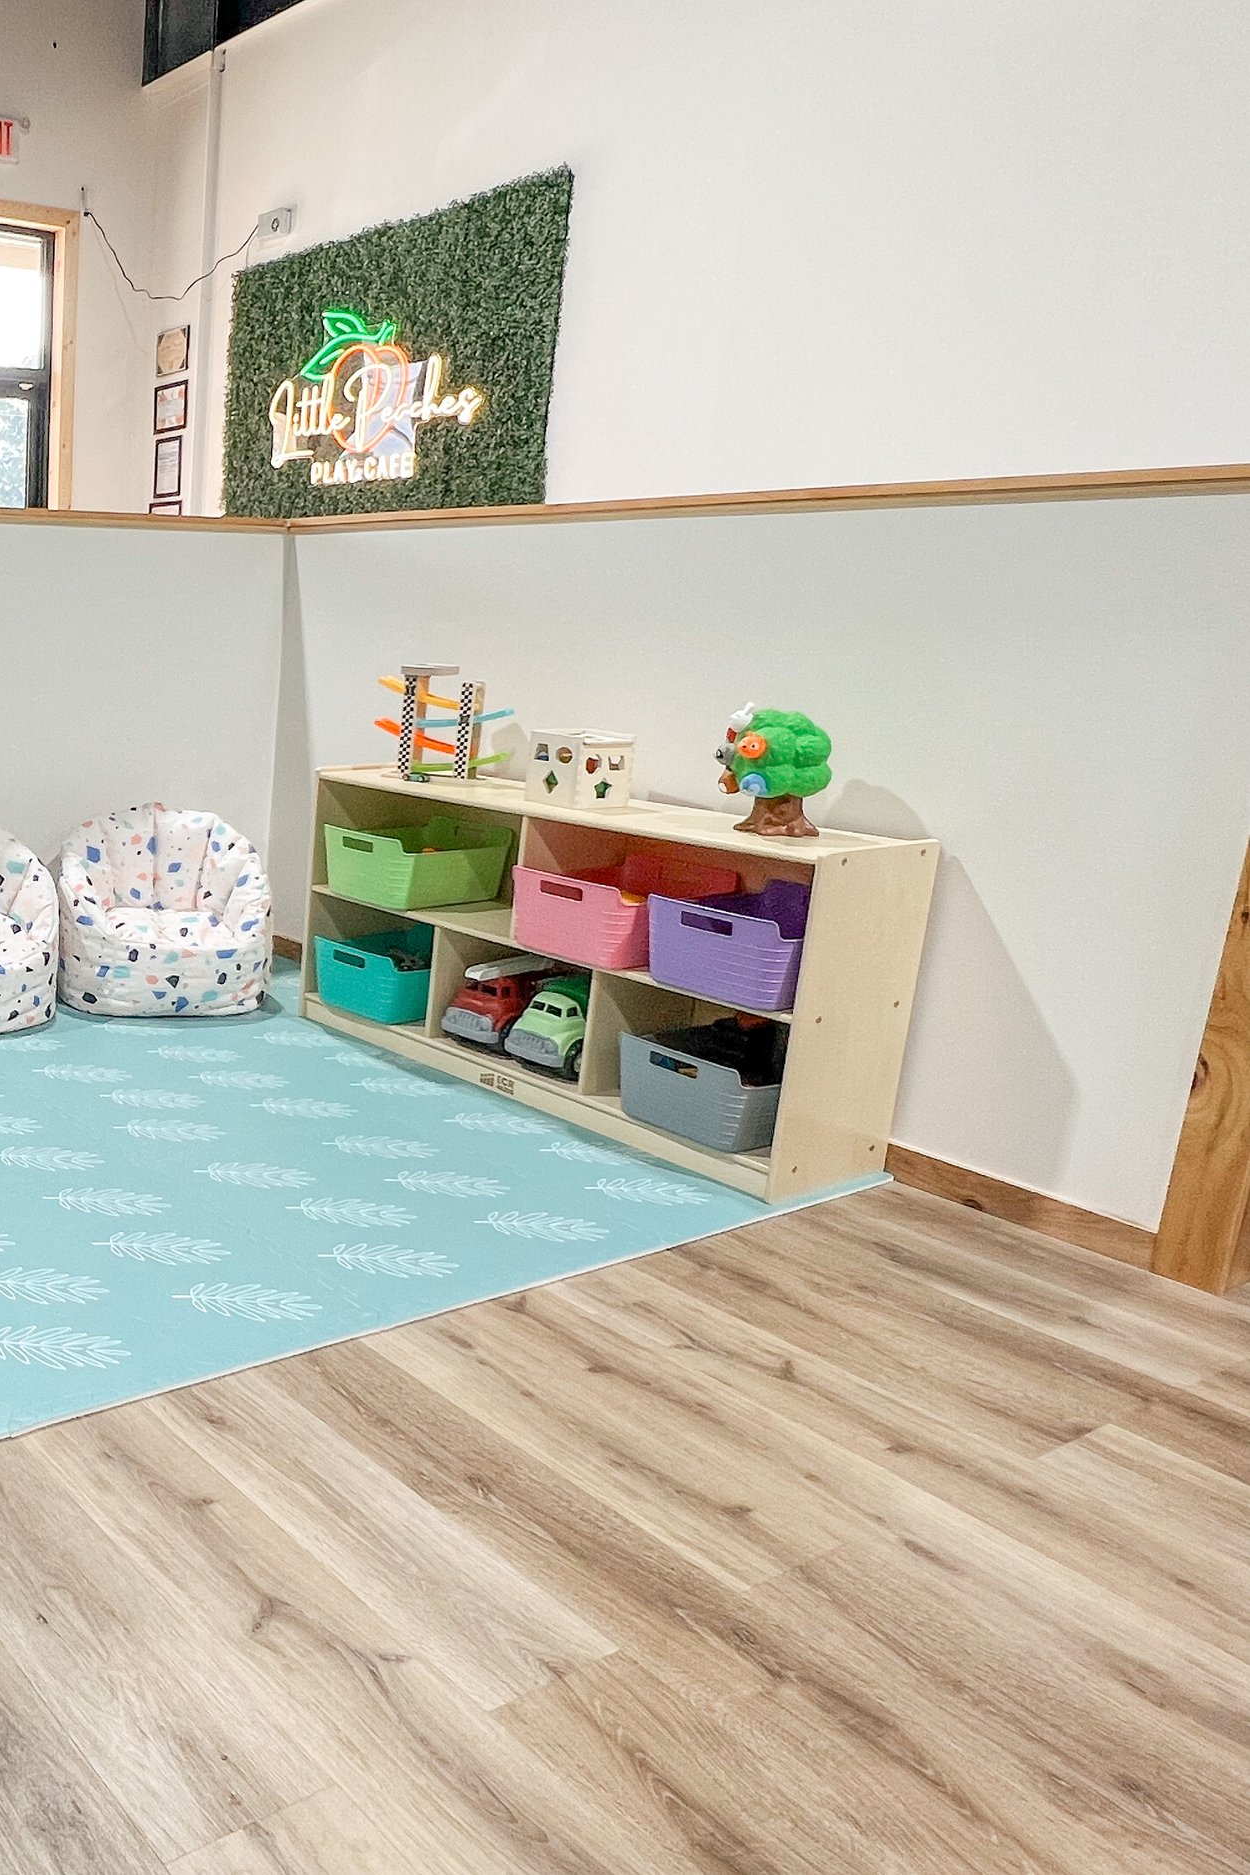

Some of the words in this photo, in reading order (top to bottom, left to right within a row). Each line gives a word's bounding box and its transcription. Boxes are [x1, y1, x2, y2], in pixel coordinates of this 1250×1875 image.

[269, 371, 351, 469] Little
[343, 352, 485, 451] Peaches
[310, 459, 357, 485] PLAY
[363, 452, 415, 481] CAFE
